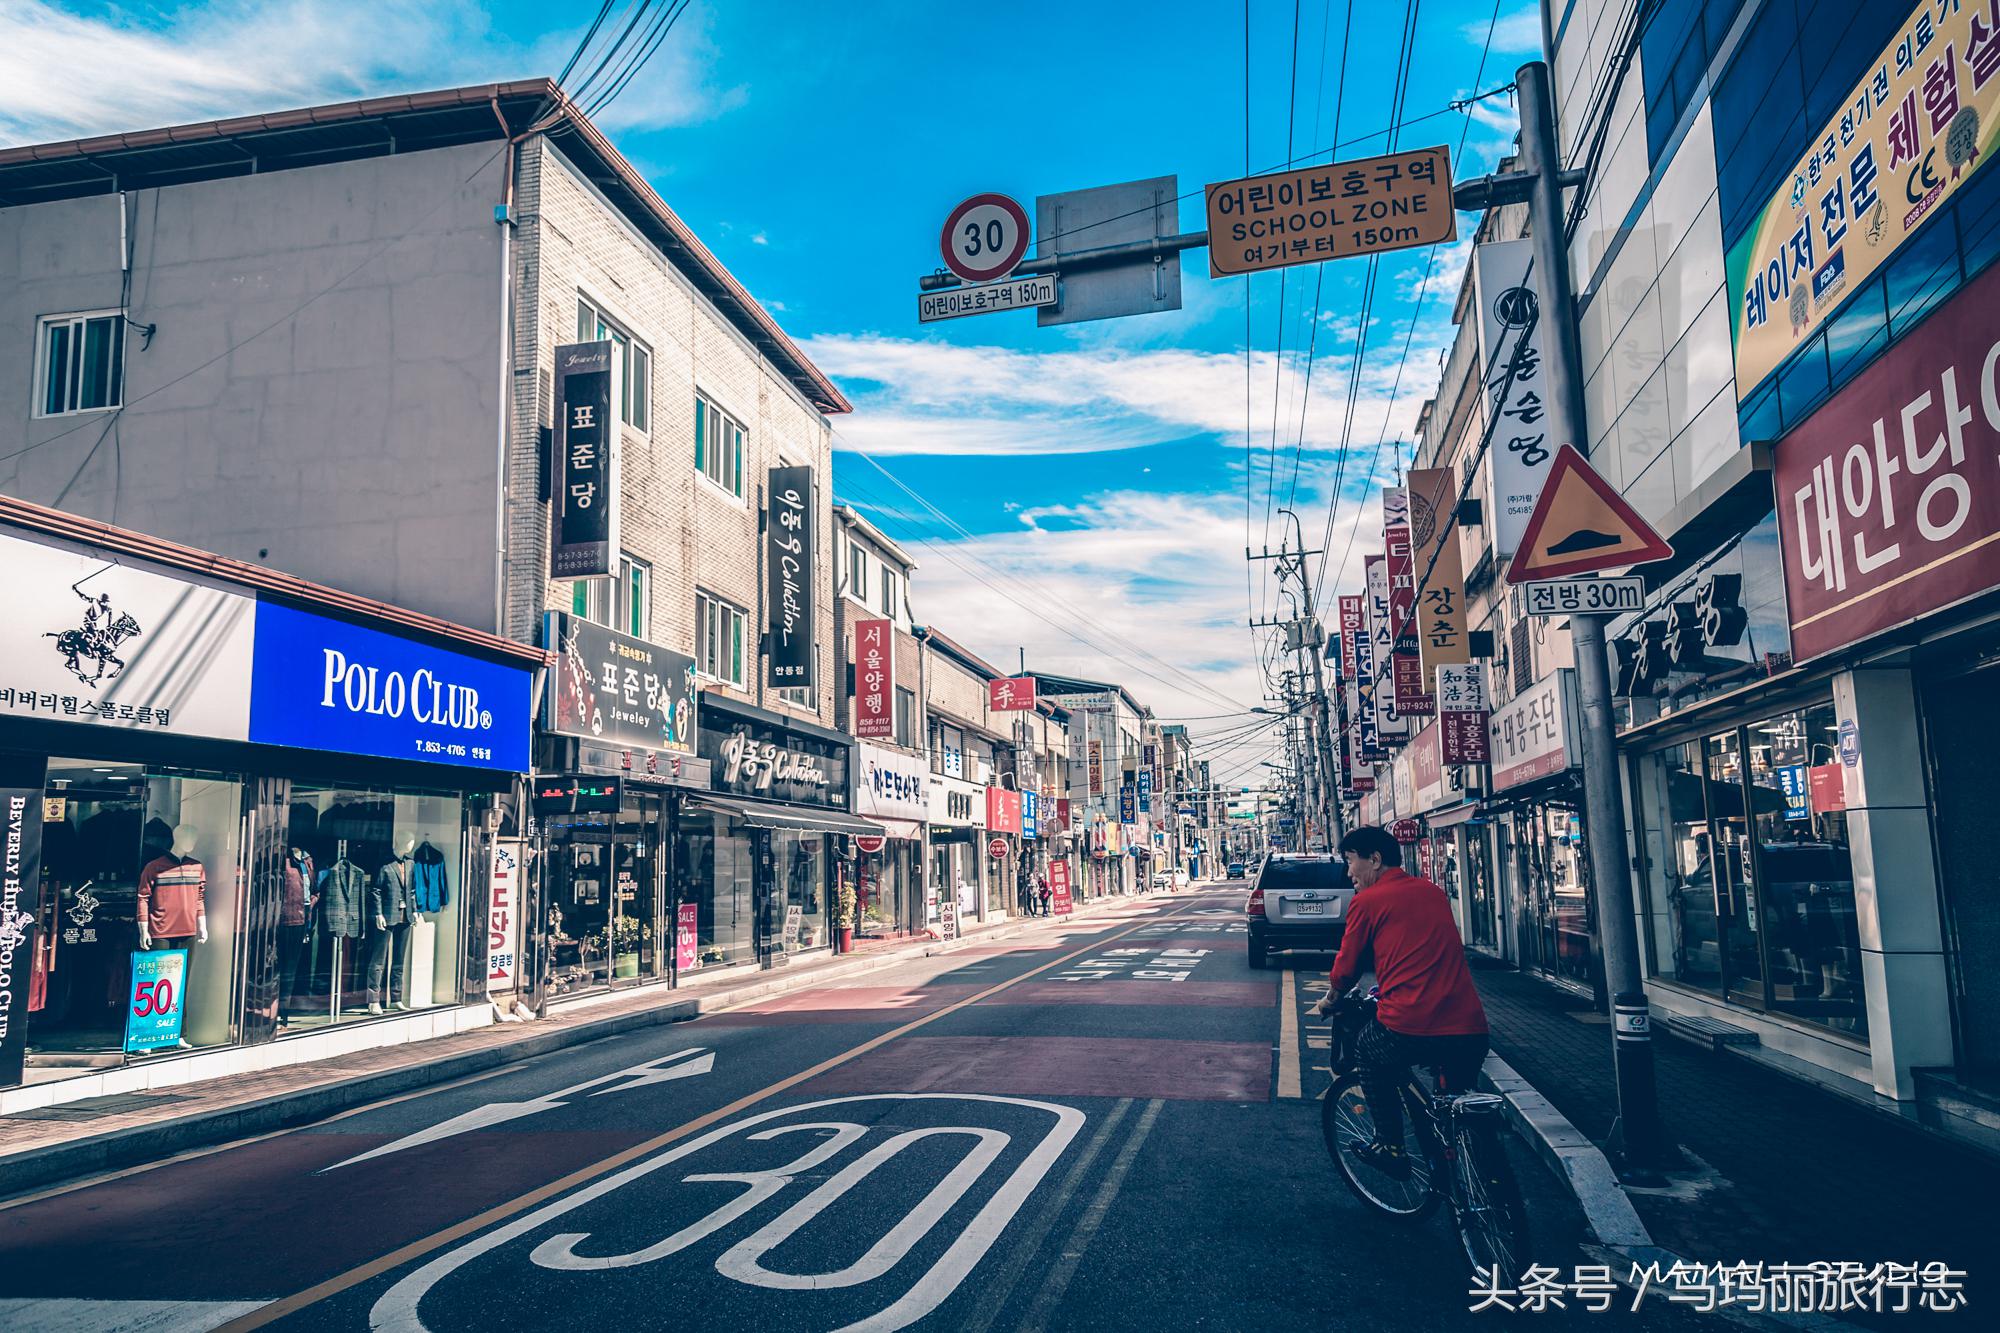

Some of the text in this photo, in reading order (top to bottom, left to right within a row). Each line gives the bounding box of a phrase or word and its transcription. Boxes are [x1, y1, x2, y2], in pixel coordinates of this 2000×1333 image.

[1807, 133, 1837, 189] 한국
[1218, 156, 1437, 217] 어린이보호구역
[963, 219, 1005, 258] 30
[1231, 194, 1428, 242] SCHOOL ZONE
[1745, 215, 1815, 332] 레이저
[1819, 142, 1880, 249] 전문
[1243, 225, 1419, 264] 여기부터 150m
[922, 281, 1052, 317] 어린이보호구역 150m
[571, 404, 596, 510] 표준당
[781, 556, 805, 648] Collection
[1425, 587, 1457, 648] 장춘
[1533, 582, 1638, 610] 전방 30m
[320, 648, 406, 718] POLO
[601, 662, 661, 710] 표준당
[775, 665, 805, 676] 안동점
[864, 626, 885, 713] 서울양행
[1463, 665, 1484, 704] 전통서각
[993, 683, 1015, 709] 手
[1396, 701, 1434, 711] 857-9247
[859, 717, 890, 727] 856-1117
[1462, 713, 1485, 761] 대흥주단
[1503, 688, 1557, 757] 대흥주단
[415, 740, 466, 757] T.853-4705
[5, 796, 26, 874] BEVERLY
[63, 927, 98, 944] 폴로
[156, 1017, 177, 1028] SALE
[529, 1121, 1011, 1290] 30
